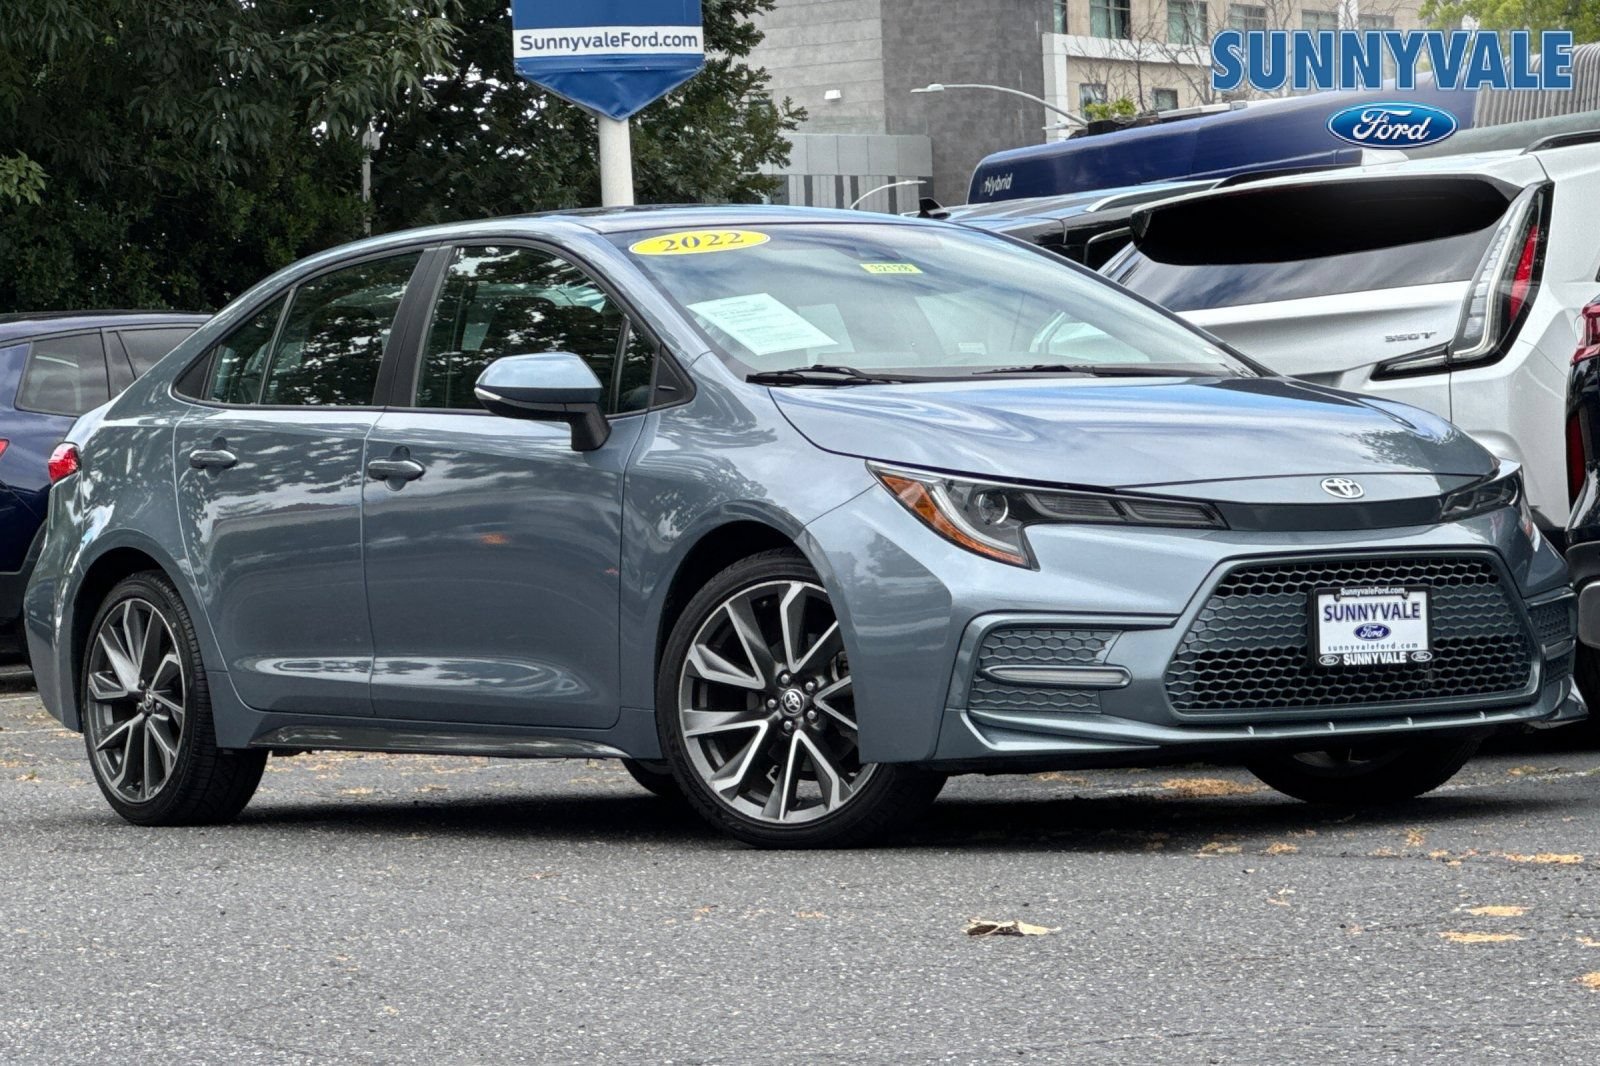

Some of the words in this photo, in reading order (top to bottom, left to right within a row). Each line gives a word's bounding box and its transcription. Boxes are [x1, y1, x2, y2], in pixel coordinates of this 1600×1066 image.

[520, 31, 698, 51] SunnyvaleFord.com
[984, 172, 1013, 197] Hybrid
[658, 231, 744, 252] 2022
[1340, 586, 1405, 598] SunnyvaleFord.com
[1323, 602, 1420, 622] SUNNYVALE
[1360, 625, 1384, 638] Ford
[1343, 652, 1407, 666] SUNNYVALE
